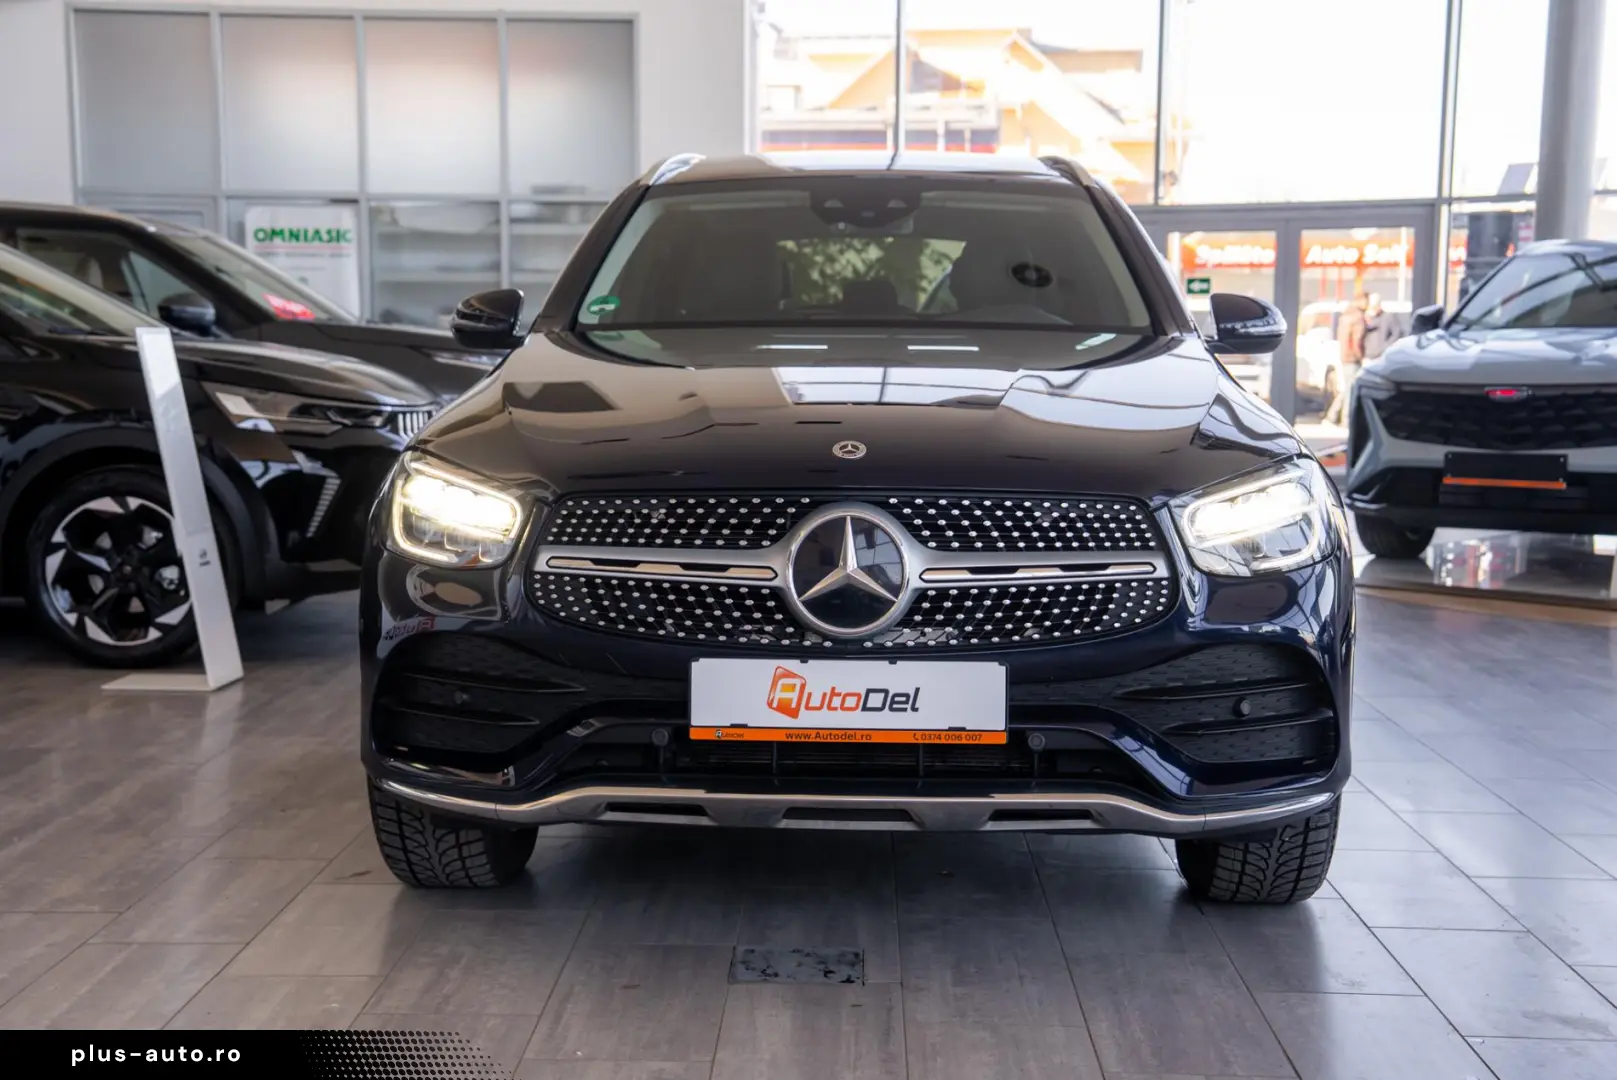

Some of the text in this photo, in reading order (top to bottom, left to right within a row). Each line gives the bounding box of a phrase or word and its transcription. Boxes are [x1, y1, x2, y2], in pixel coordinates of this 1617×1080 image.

[253, 227, 353, 243] OMNIASIC
[768, 668, 920, 718] AutoDel
[785, 731, 872, 742] www.Autodel.ro
[920, 732, 983, 743] 0374 006 007
